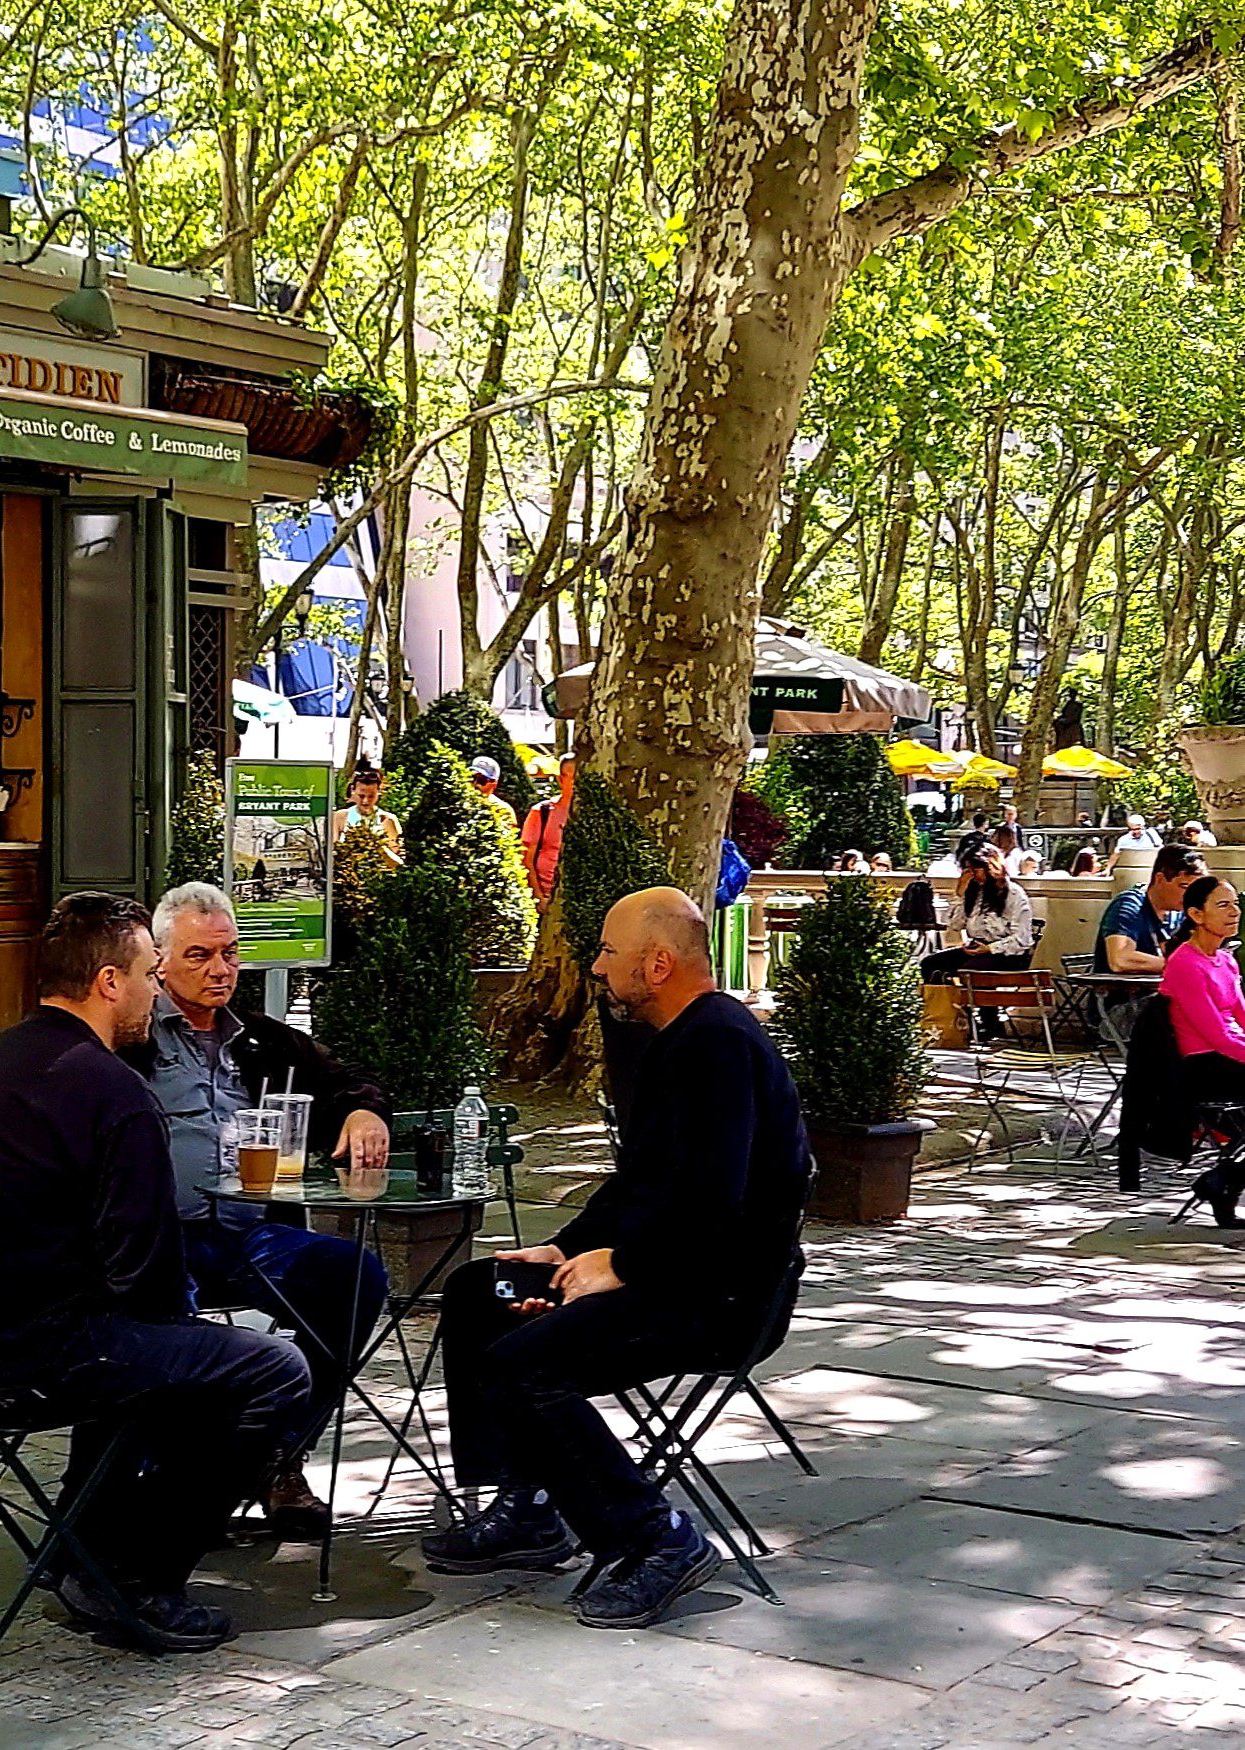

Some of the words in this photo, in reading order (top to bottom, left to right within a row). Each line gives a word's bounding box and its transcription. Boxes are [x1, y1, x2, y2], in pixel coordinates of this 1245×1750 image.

[61, 421, 115, 445] Coffee
[128, 432, 144, 451] &
[151, 433, 242, 462] Lemonades
[775, 687, 818, 699] PARK
[238, 784, 271, 796] Public
[238, 802, 281, 810] BRYANT
[283, 802, 311, 811] PARK
